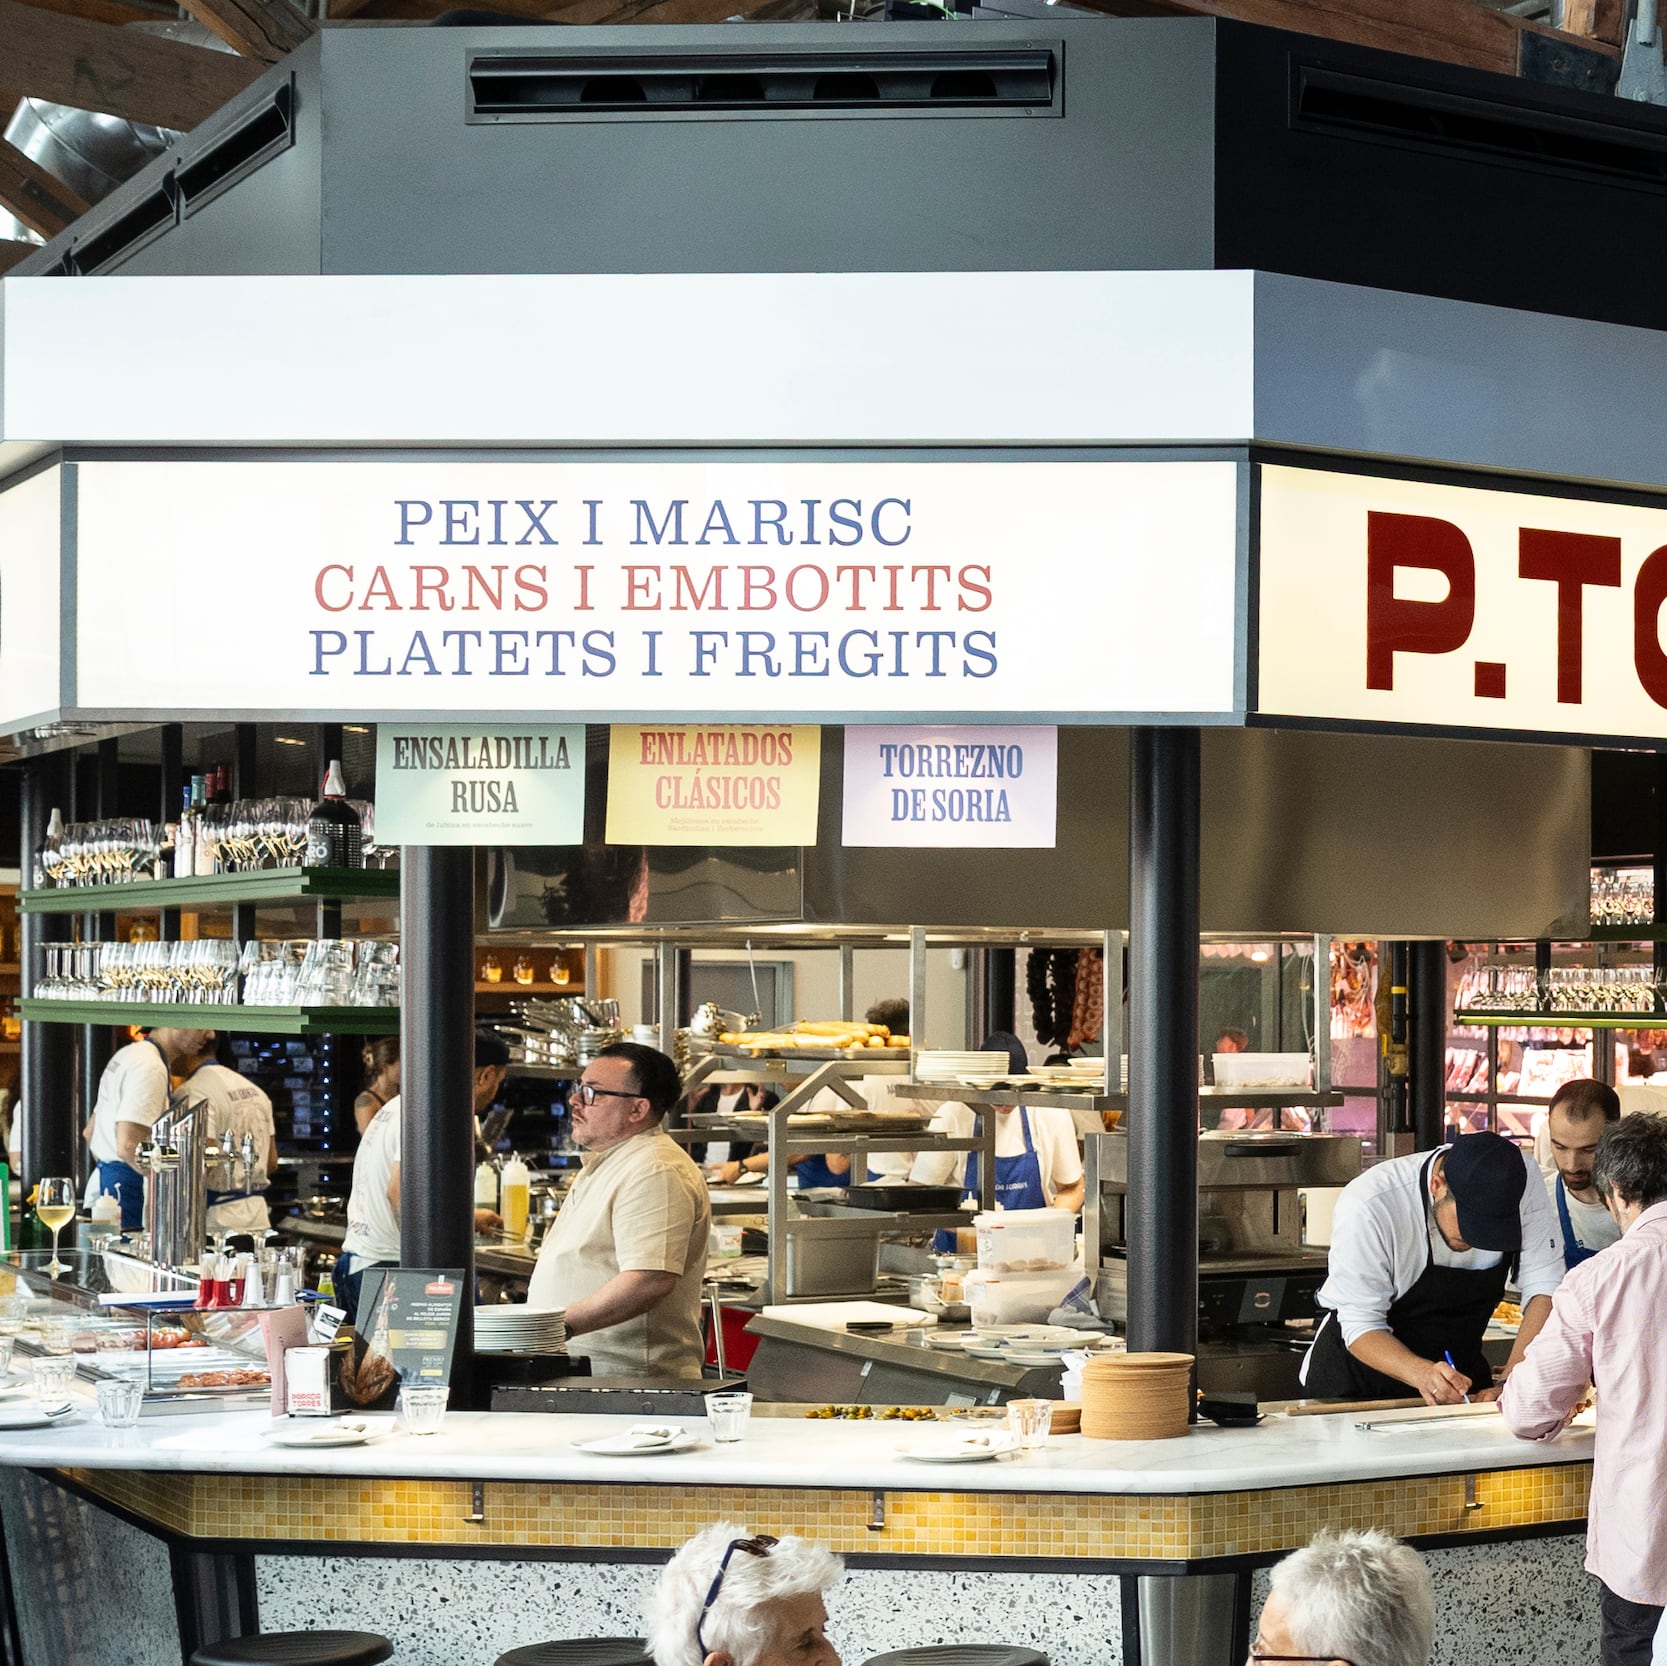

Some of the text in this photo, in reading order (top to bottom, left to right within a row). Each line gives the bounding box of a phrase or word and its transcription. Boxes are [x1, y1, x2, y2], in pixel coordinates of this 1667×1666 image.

[392, 497, 914, 549] PEIX I MARISC
[312, 562, 996, 615] CARNS I EMBOTITS
[307, 629, 1001, 681] PLATETS I FREGITS
[392, 736, 571, 770] ENSALADILLA
[639, 732, 792, 766] ENLATADOS
[879, 743, 1023, 779] TORREZNO
[450, 780, 519, 814] RUSA
[655, 770, 781, 810] CLÁSICOS
[891, 788, 1012, 823] DE SORIA
